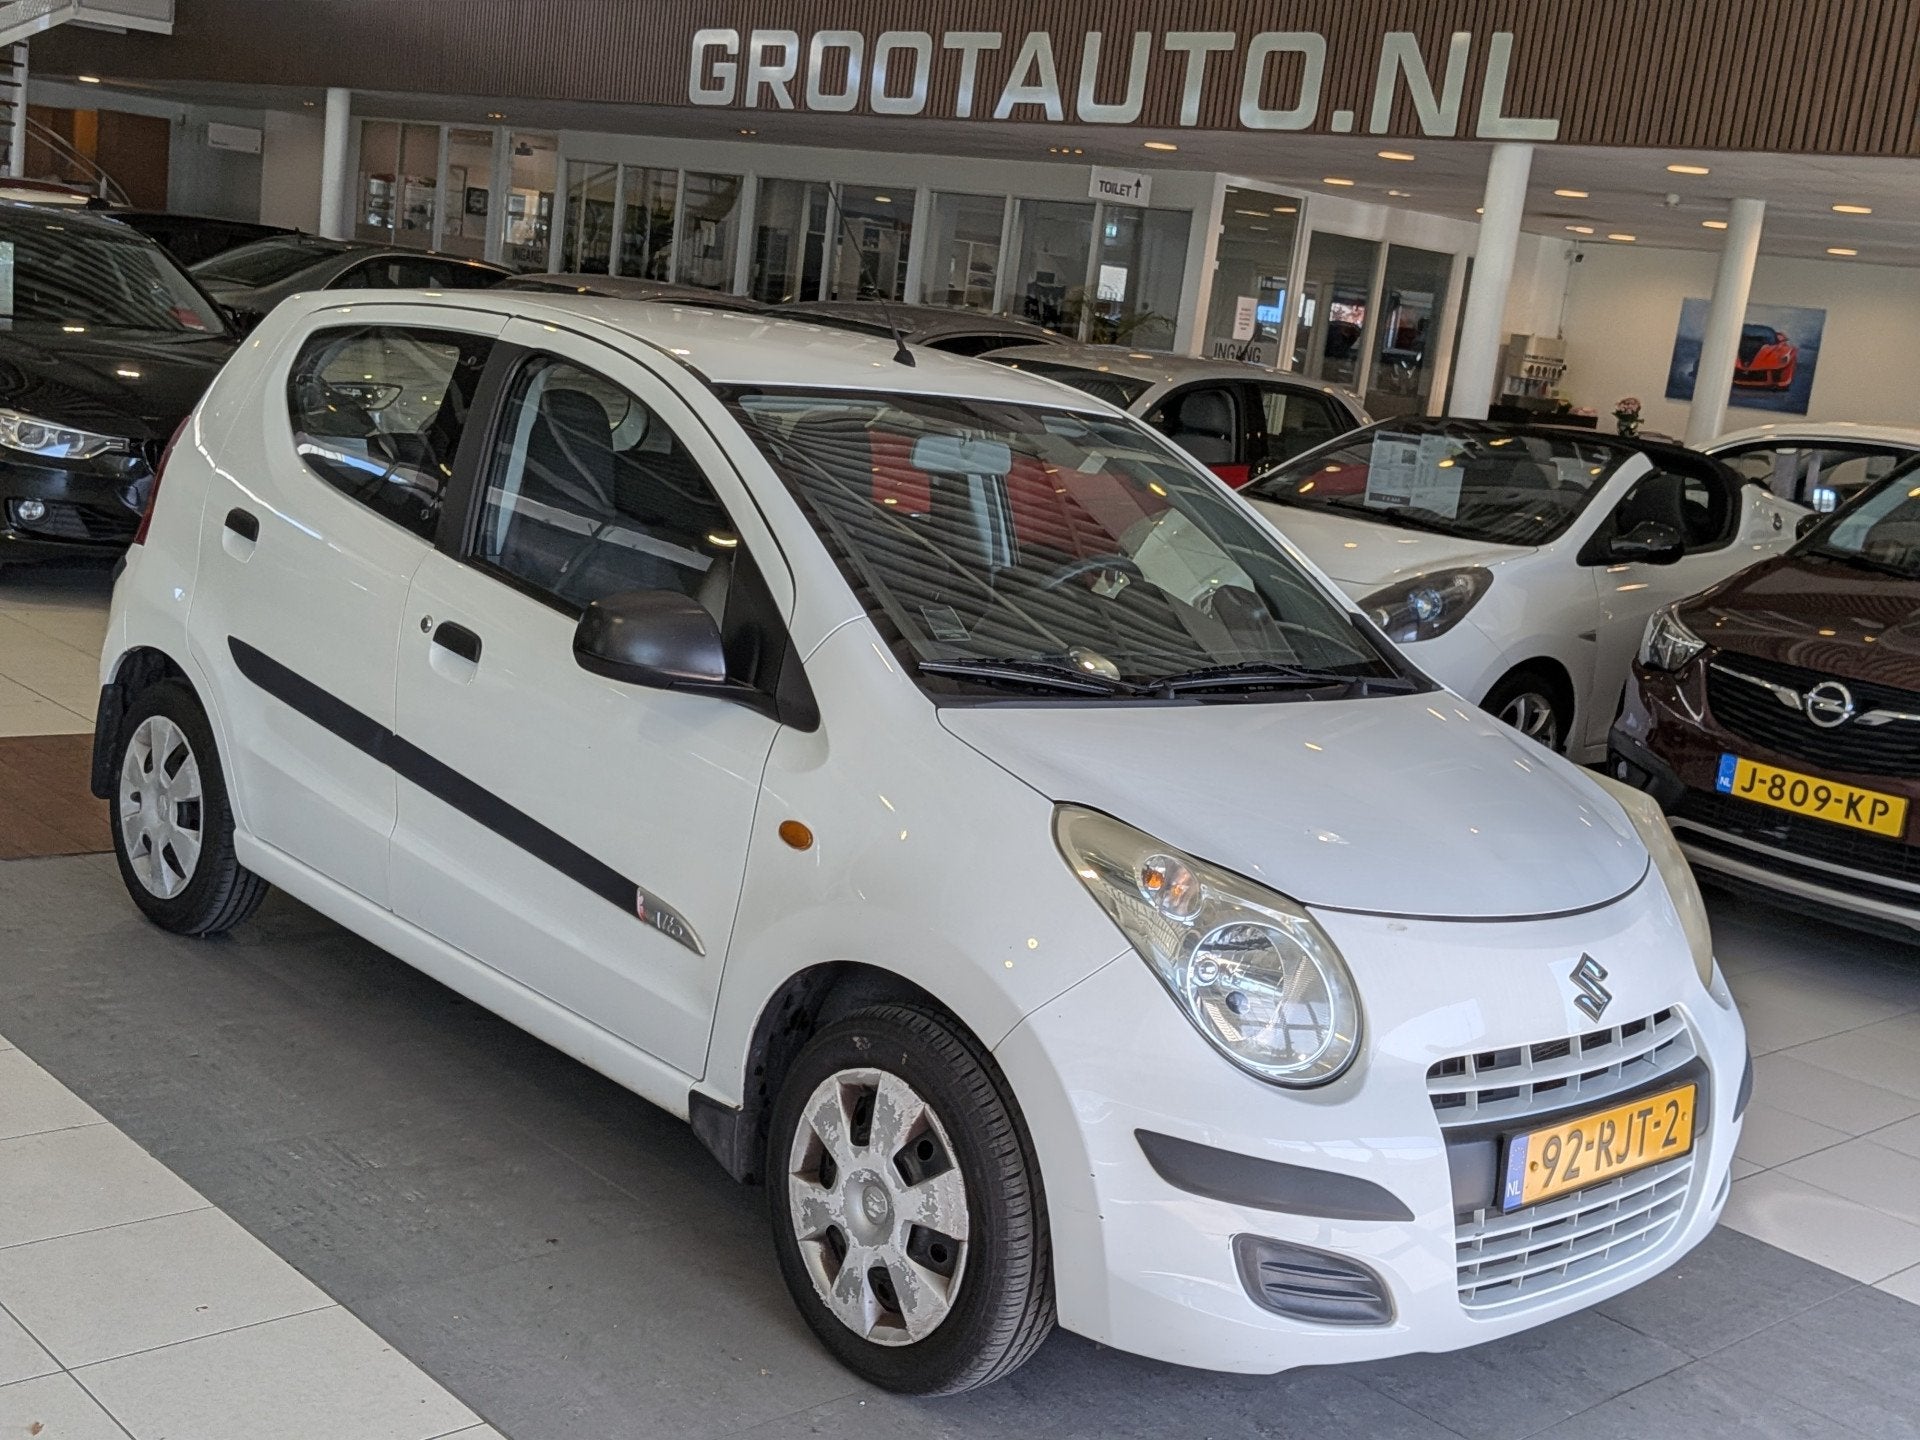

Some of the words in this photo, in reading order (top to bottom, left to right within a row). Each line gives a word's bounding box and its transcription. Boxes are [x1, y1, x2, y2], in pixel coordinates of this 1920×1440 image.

[688, 28, 1560, 141] GROOTAUTO.NL
[1099, 180, 1132, 197] TOILET
[1213, 342, 1261, 362] INGANG
[1719, 776, 1731, 788] NL
[1740, 767, 1890, 825] J-809-KP
[1507, 1181, 1521, 1197] NL
[1542, 1100, 1680, 1188] 92-RJT-2
